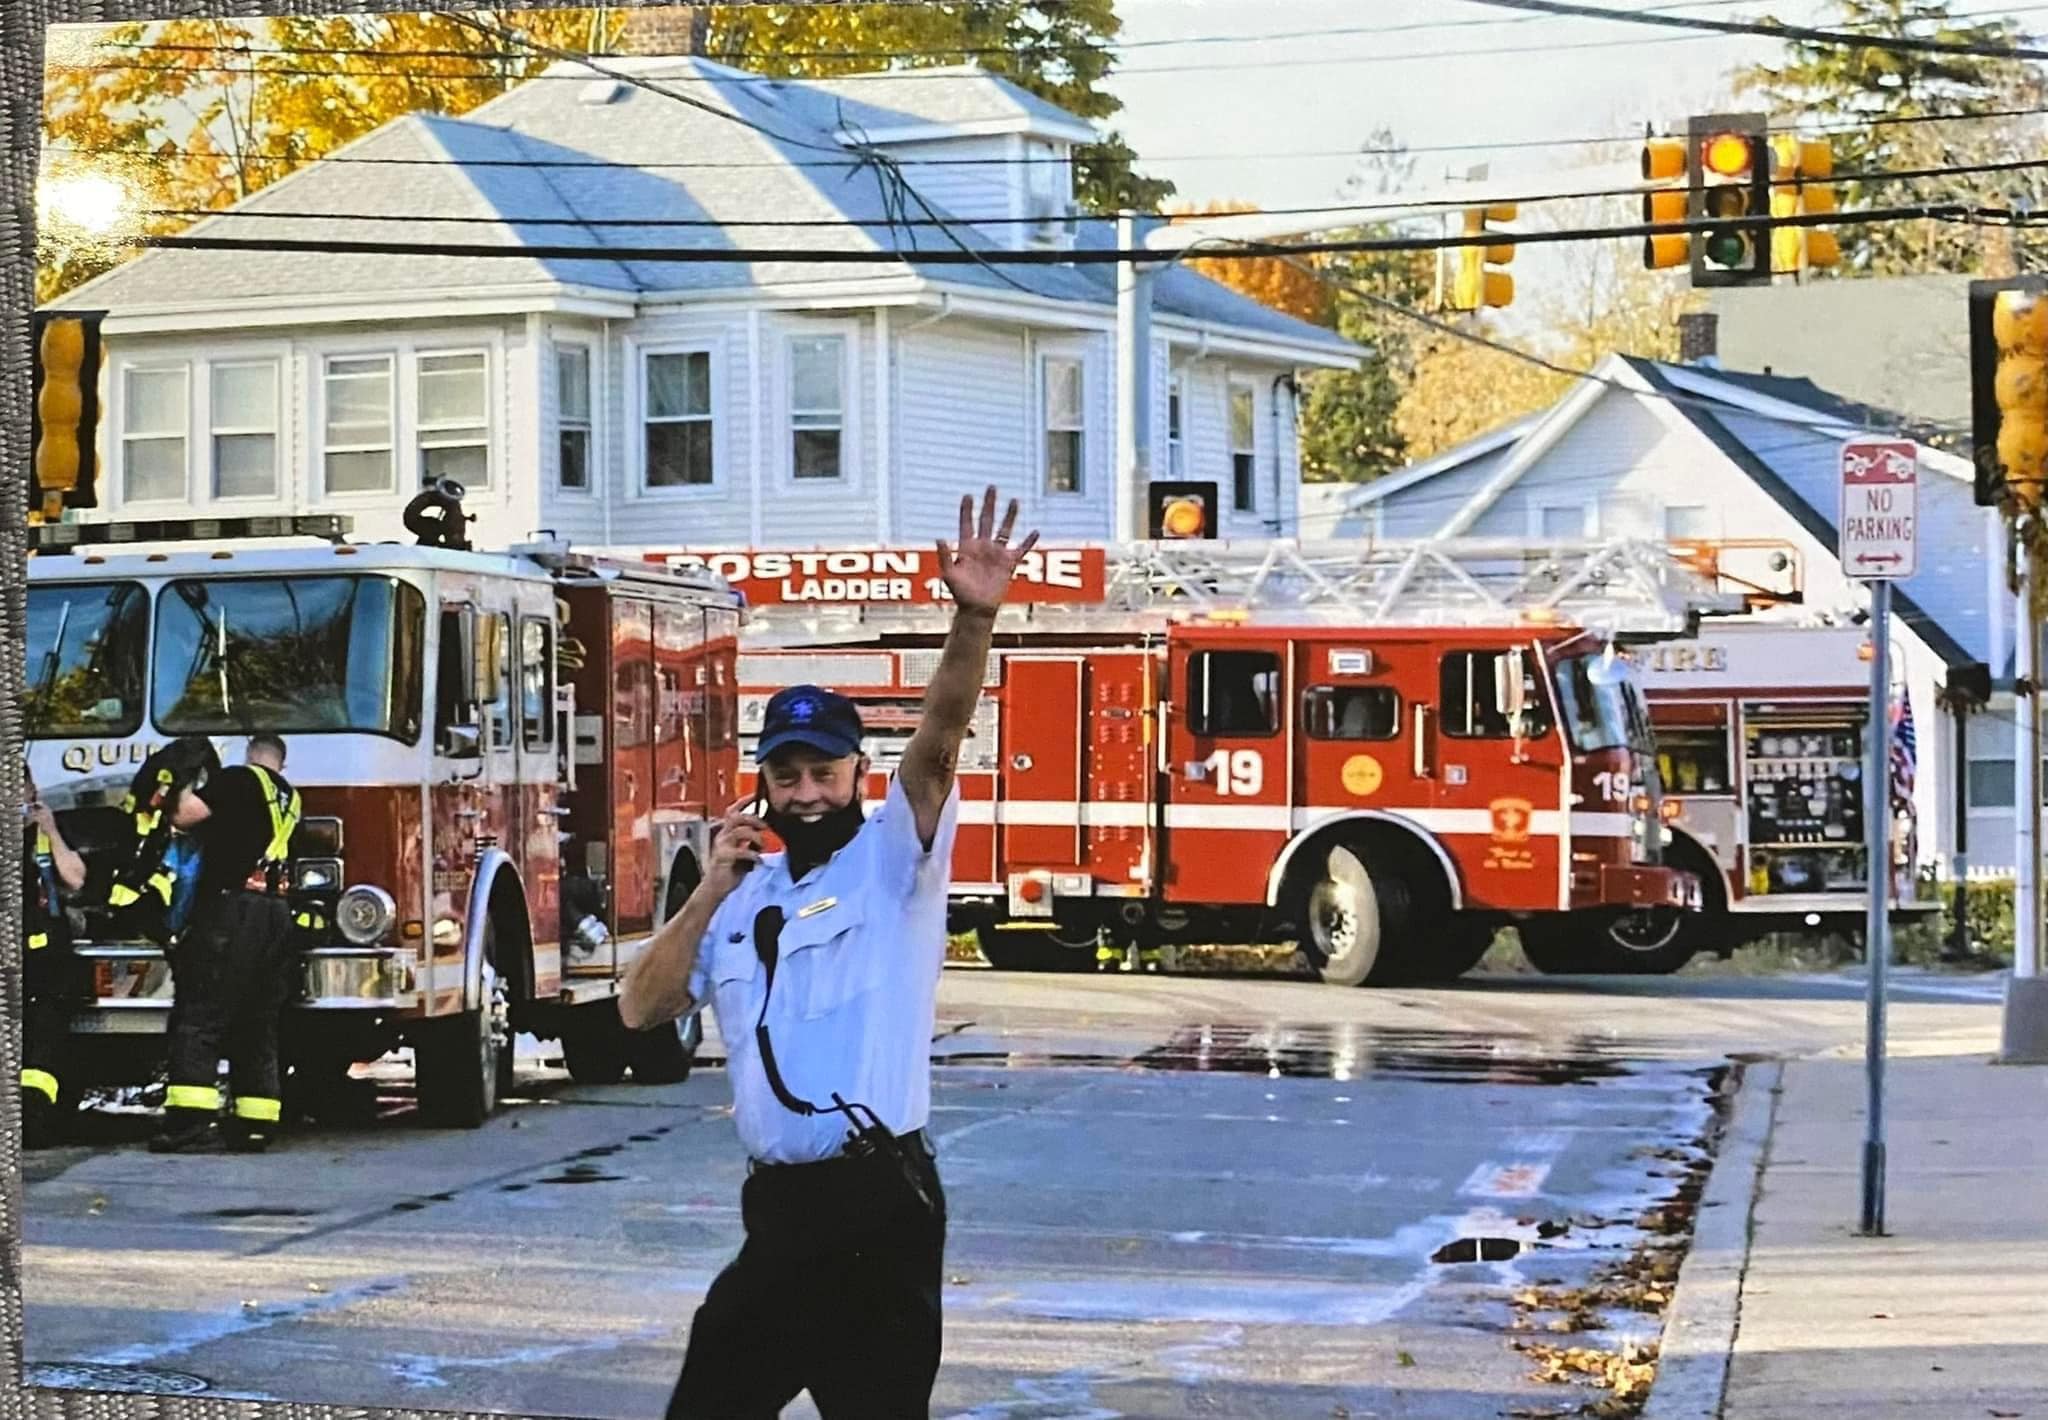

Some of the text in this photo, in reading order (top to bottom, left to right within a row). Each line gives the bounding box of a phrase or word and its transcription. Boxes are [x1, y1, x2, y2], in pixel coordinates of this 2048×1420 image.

[1866, 488, 1892, 512] NO
[1847, 517, 1912, 541] PARKING
[781, 577, 912, 600] LADDER
[1205, 749, 1263, 796] 19
[1593, 771, 1629, 802] 19
